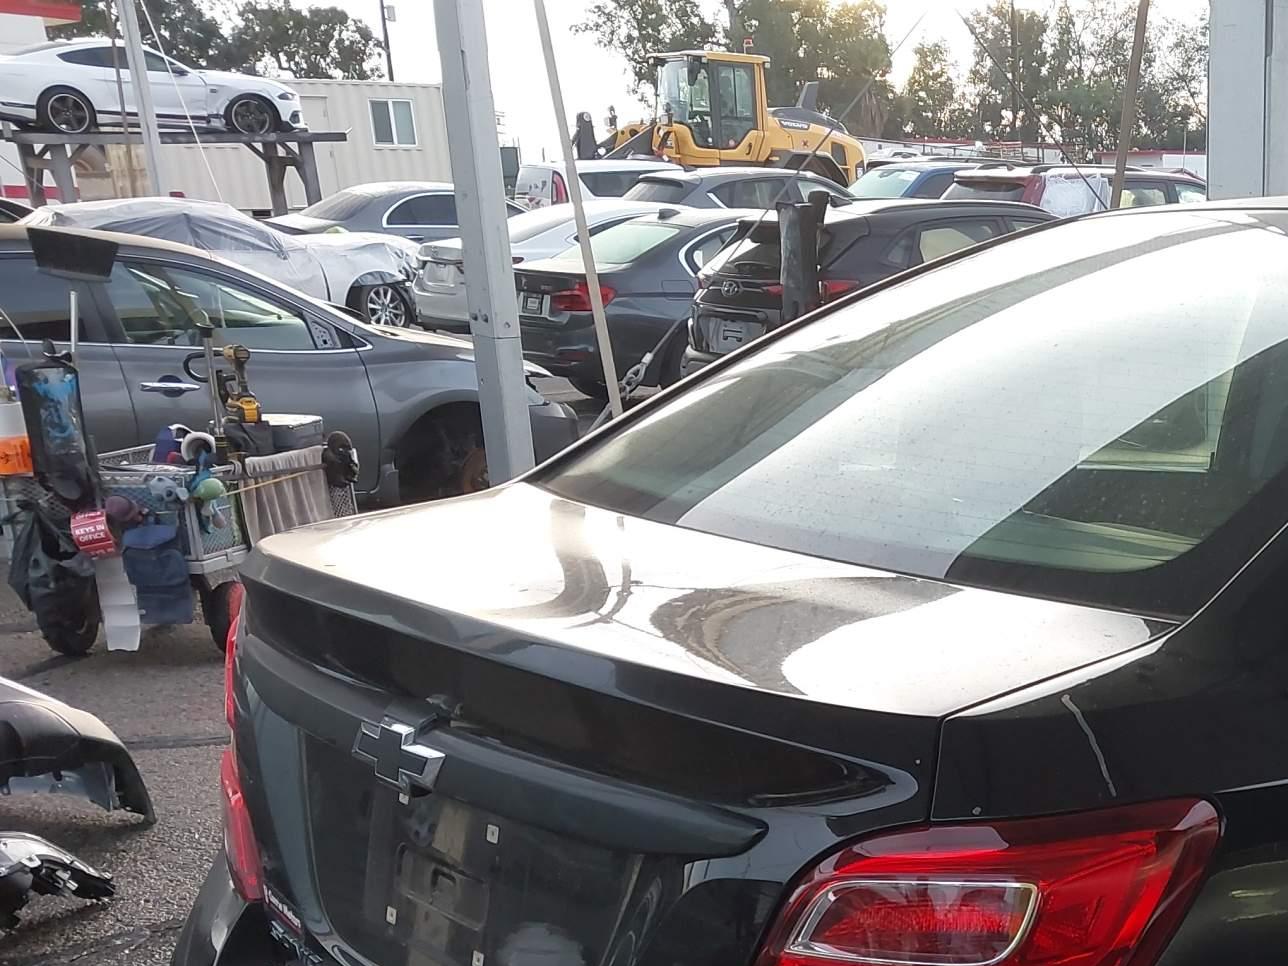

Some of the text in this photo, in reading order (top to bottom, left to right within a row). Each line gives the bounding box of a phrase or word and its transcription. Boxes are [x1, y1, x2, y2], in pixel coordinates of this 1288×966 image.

[75, 523, 105, 536] KEYS IN
[79, 531, 106, 542] OFFICE
